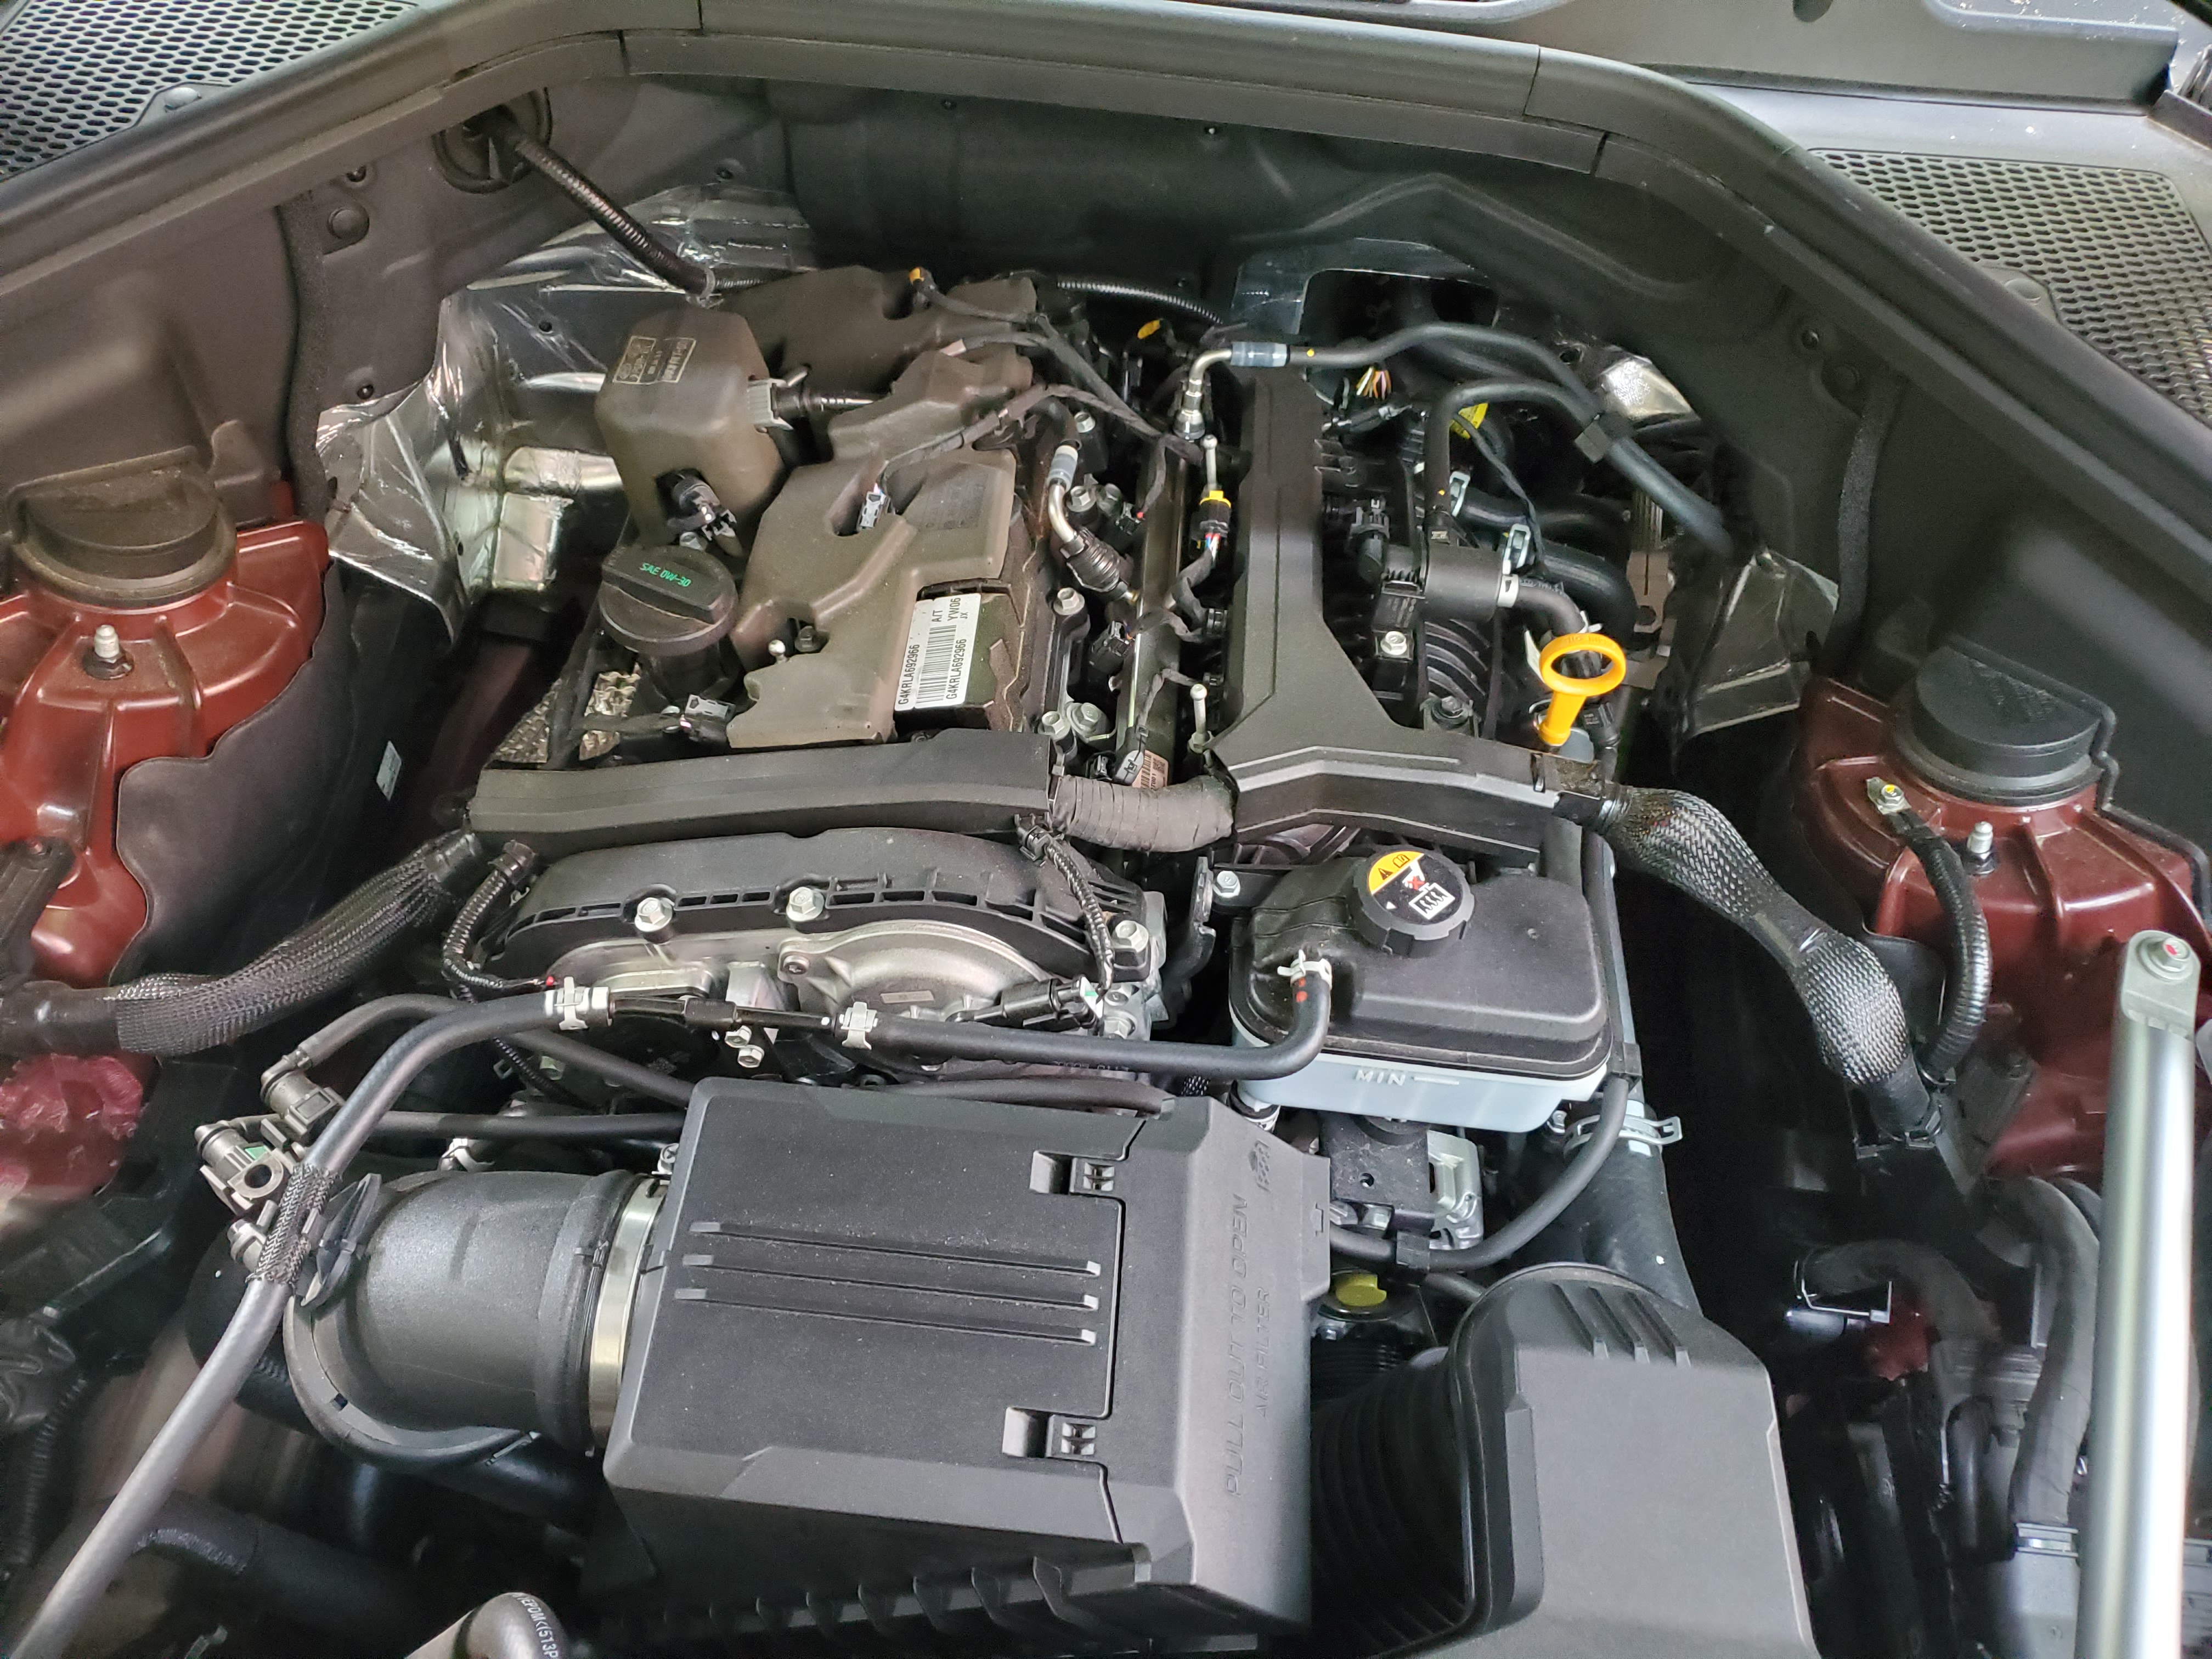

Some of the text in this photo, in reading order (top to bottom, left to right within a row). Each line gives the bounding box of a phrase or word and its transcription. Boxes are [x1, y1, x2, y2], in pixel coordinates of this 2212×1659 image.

[639, 563, 691, 586] SAE 0W-30
[932, 610, 943, 622] A/T
[947, 597, 961, 621] YW06
[898, 644, 919, 704] G4KRLA692966
[946, 639, 967, 699] G4KRLA692966
[1355, 1069, 1406, 1086] MIN
[1227, 1193, 1248, 1497] PULL OUT TO OPEN
[1256, 1287, 1269, 1418] AIR FILTER
